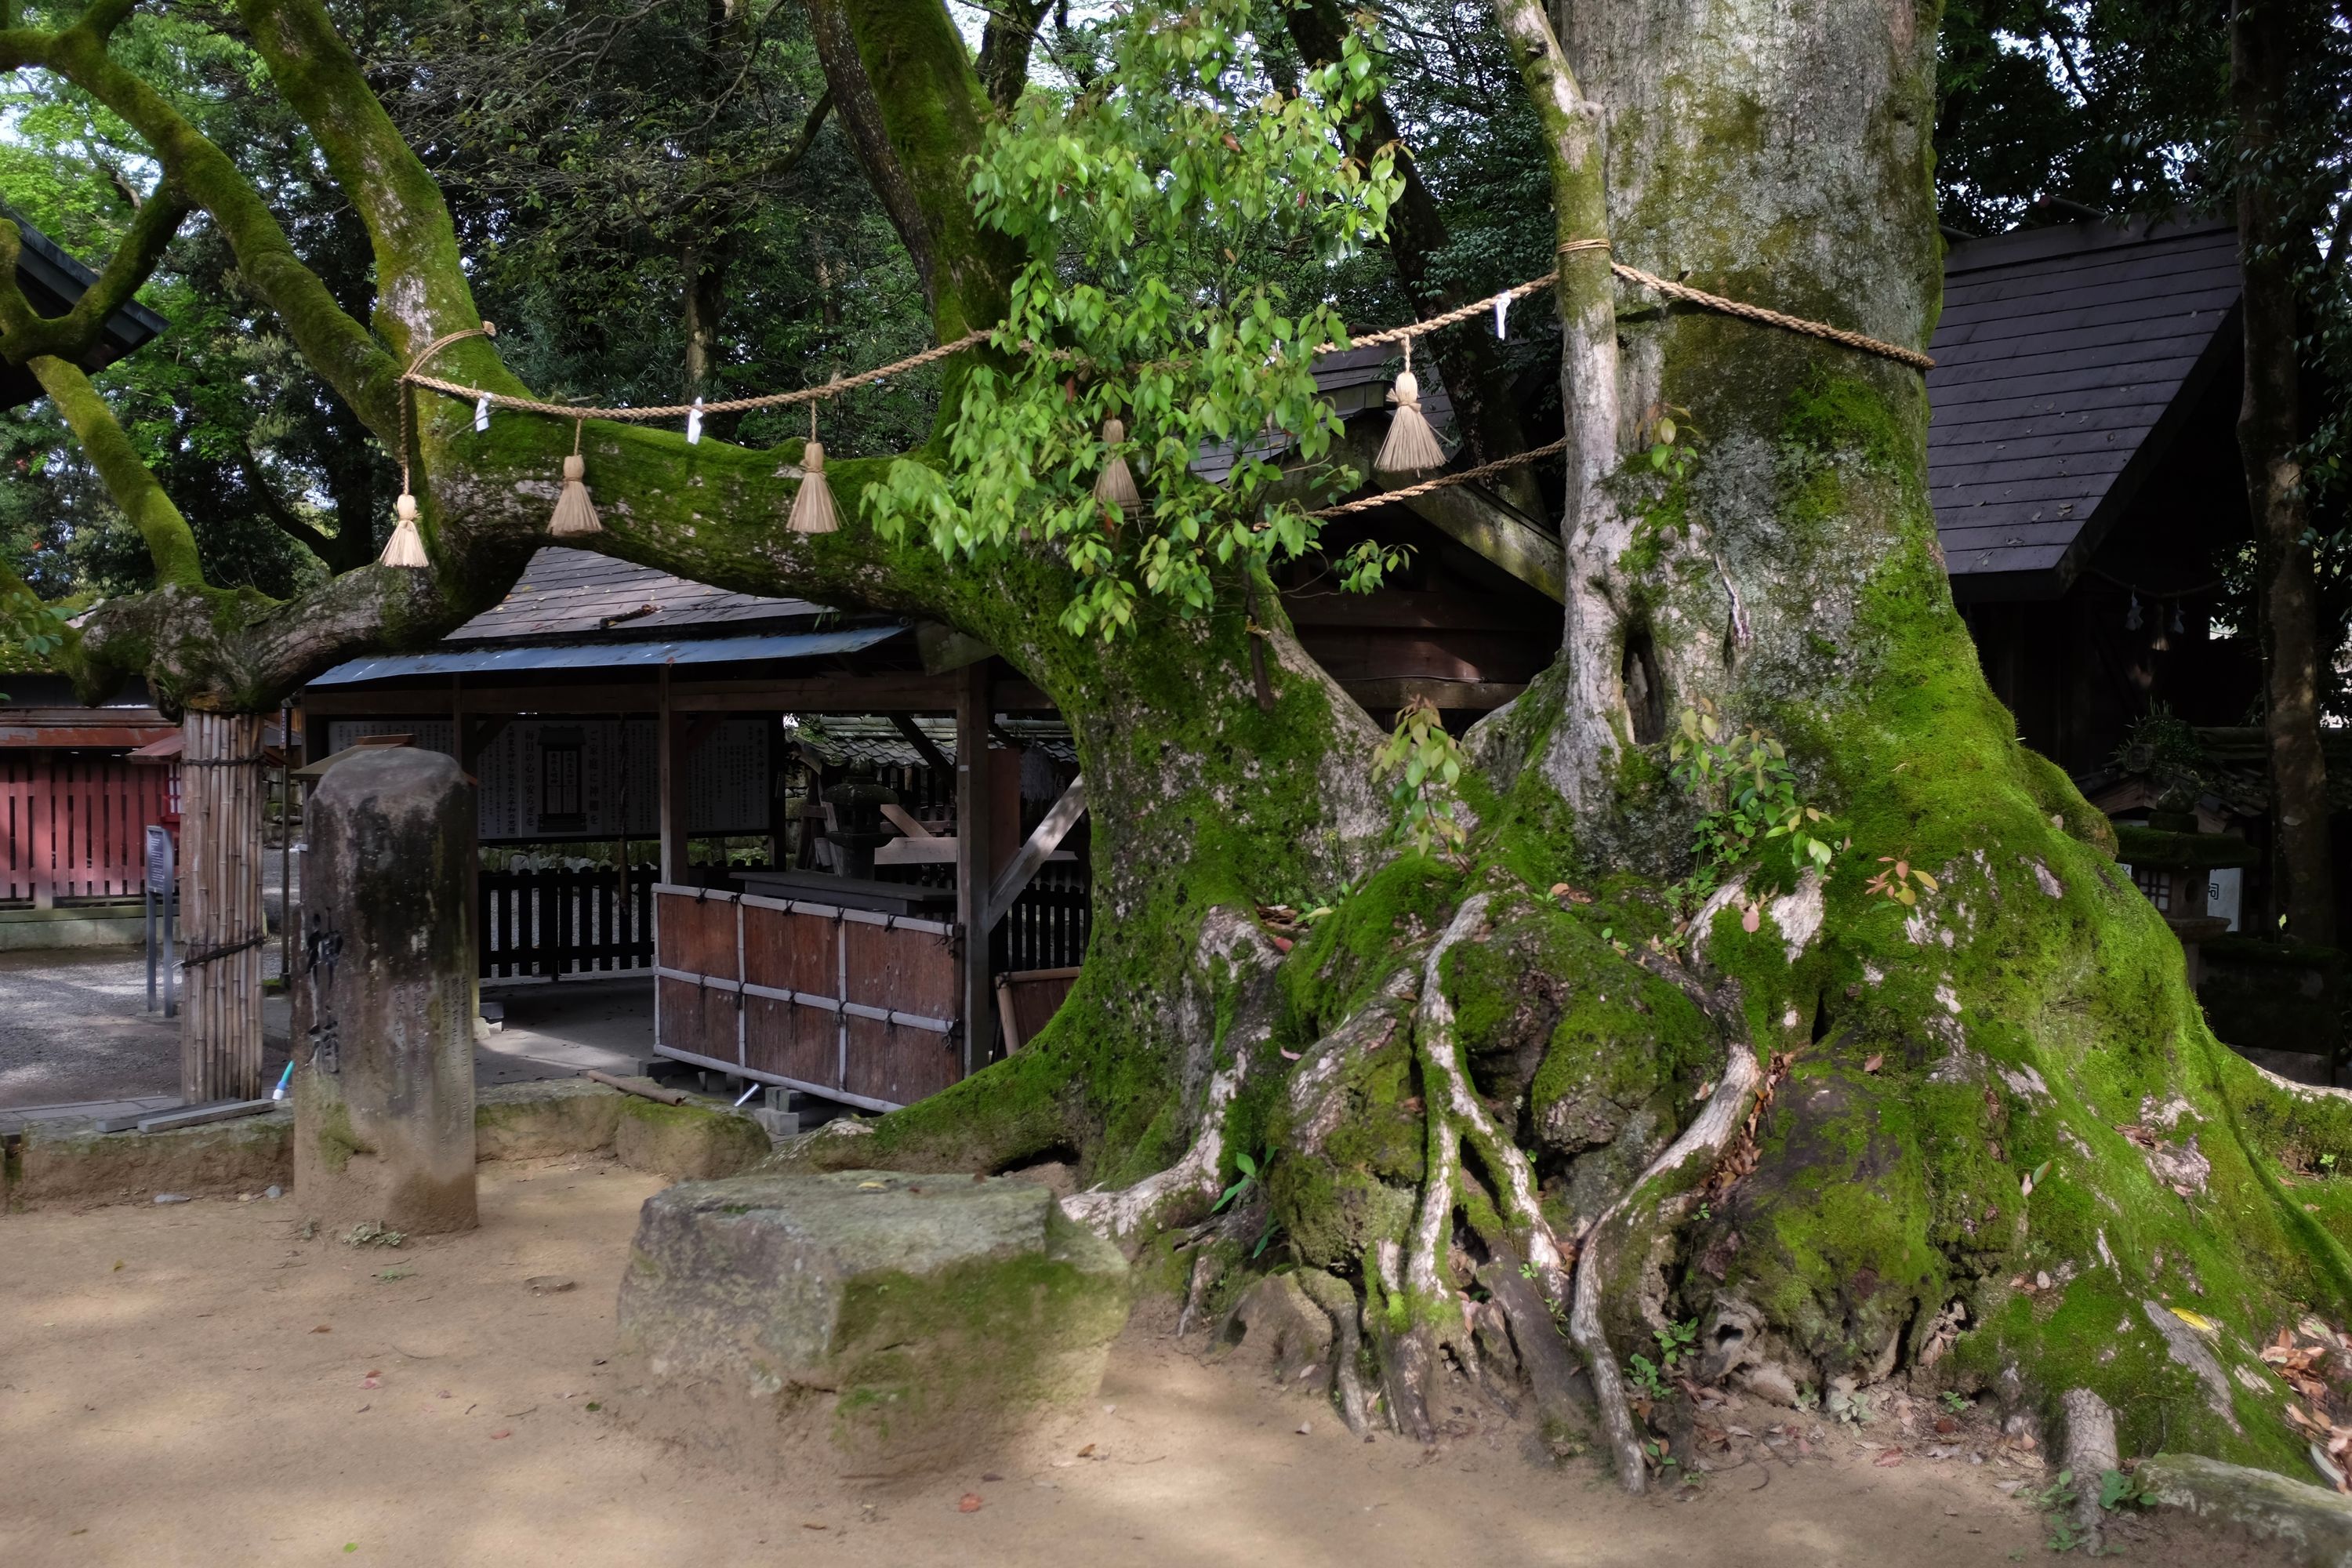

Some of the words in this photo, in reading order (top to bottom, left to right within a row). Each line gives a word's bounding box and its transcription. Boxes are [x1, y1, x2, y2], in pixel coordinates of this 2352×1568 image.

[525, 730, 535, 826] 毎日の心の安らぎを
